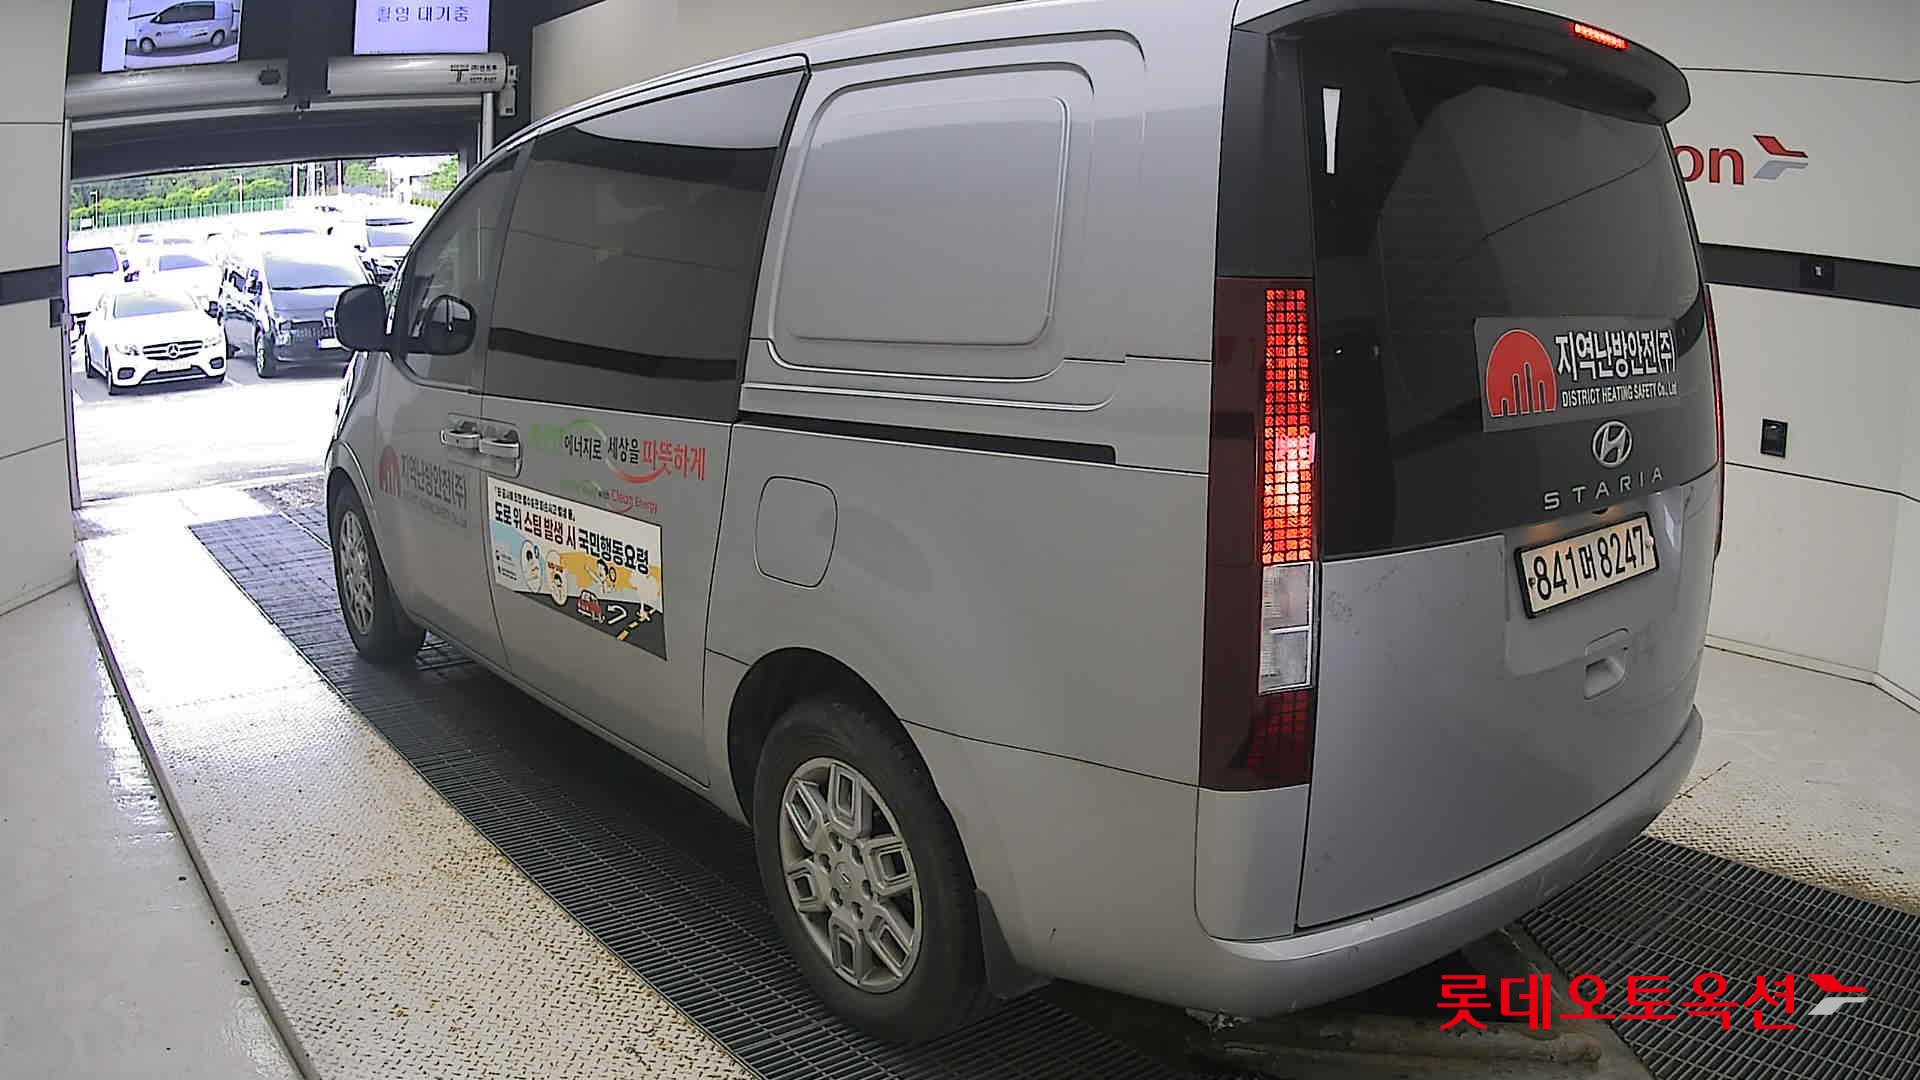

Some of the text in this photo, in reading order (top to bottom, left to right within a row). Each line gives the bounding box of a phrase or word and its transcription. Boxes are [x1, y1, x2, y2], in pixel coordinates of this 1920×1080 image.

[1554, 328, 1676, 381] 지역난방안전(주)
[1562, 387, 1601, 408] DISTRICT
[1602, 385, 1633, 404] HEATING
[1633, 383, 1657, 400] SAFETY
[563, 434, 602, 461] 에너지로
[608, 435, 640, 464] 세상을
[642, 439, 706, 480] 따뜻하게
[1543, 466, 1664, 510] STARIA
[495, 501, 512, 525] 도로
[513, 508, 522, 530] 위
[523, 511, 542, 536] 스팀
[544, 518, 564, 545] 발생
[565, 525, 576, 550] 시
[578, 527, 649, 575] 국민행동요령
